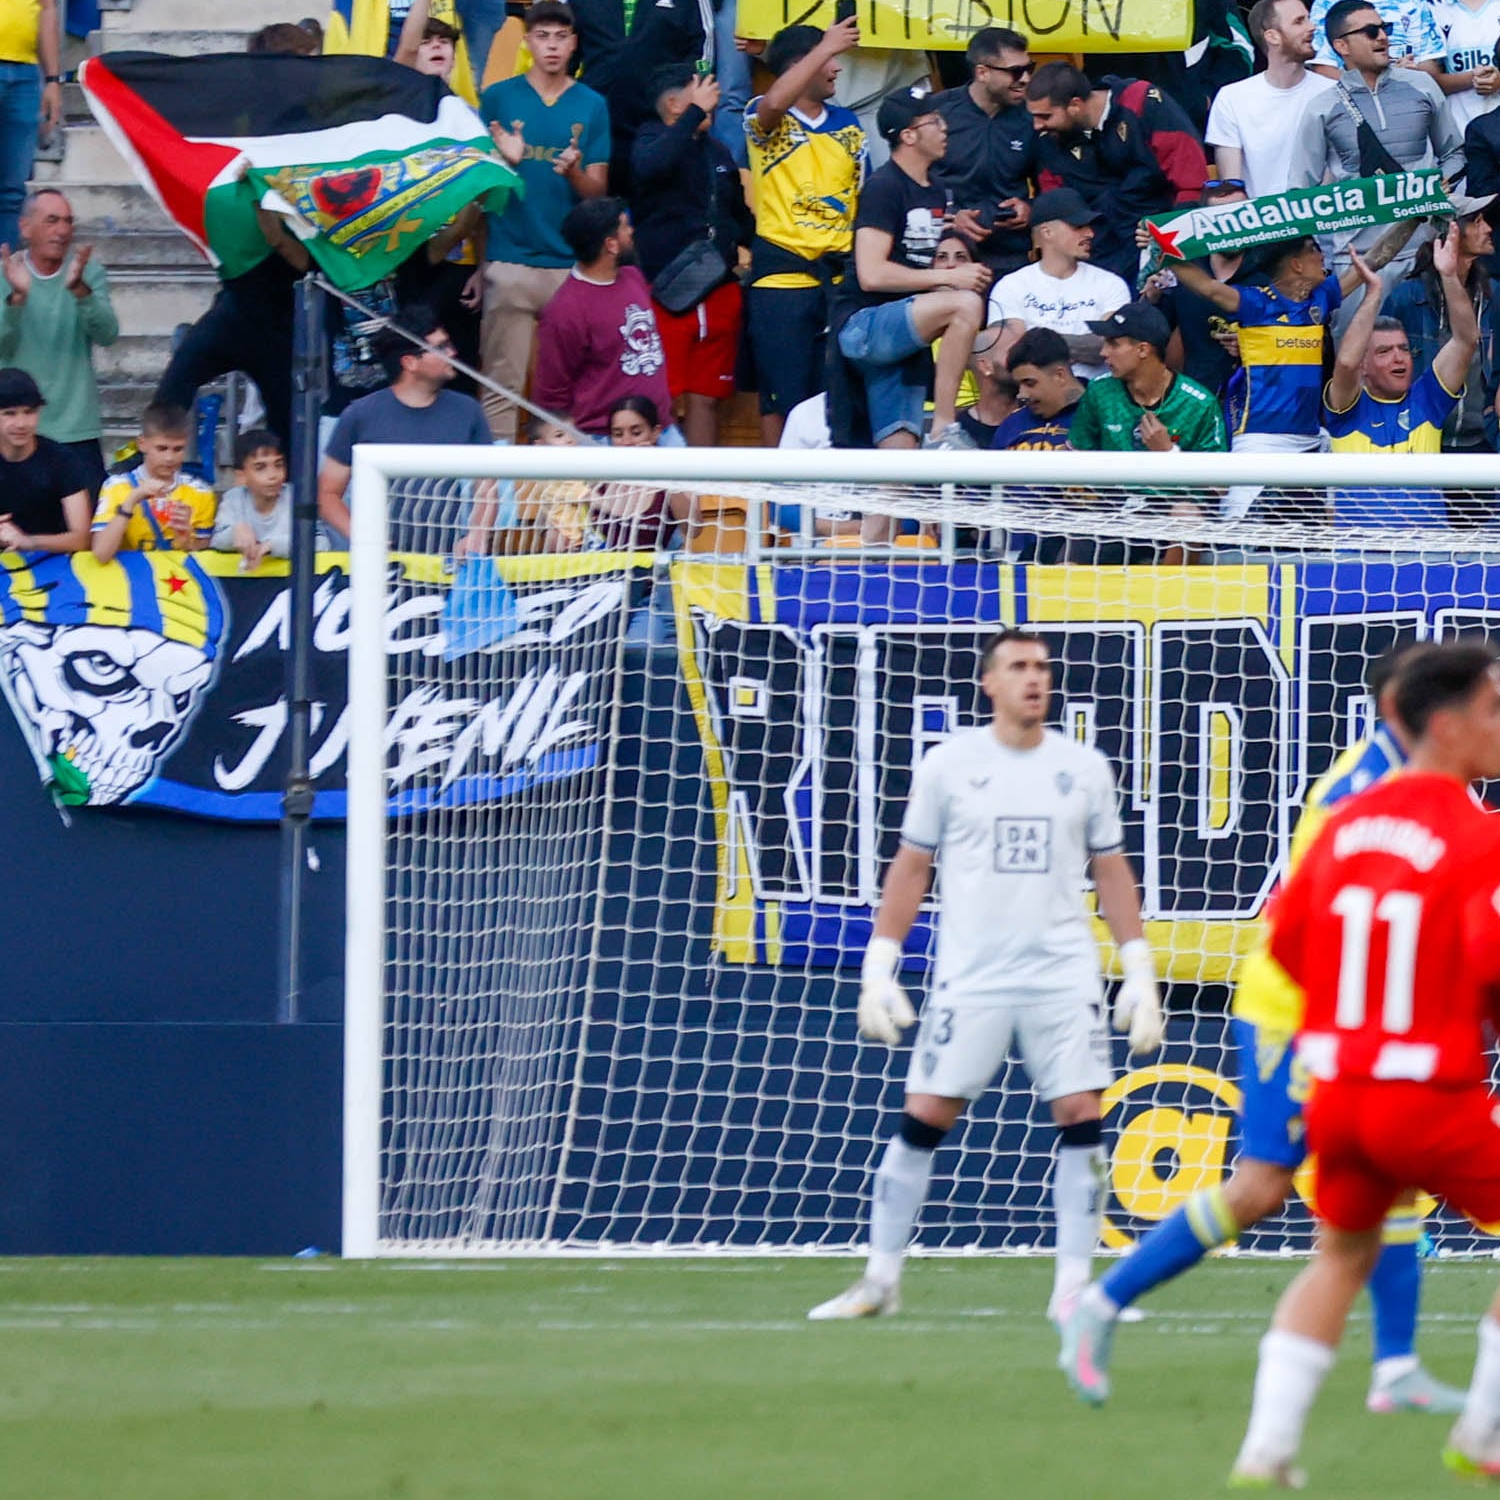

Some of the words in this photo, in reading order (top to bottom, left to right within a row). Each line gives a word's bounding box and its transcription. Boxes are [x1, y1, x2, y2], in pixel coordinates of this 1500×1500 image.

[1452, 49, 1498, 72] Silb
[1195, 184, 1366, 241] Andalucía
[1374, 168, 1442, 206] Libr
[1205, 226, 1300, 253] Independencia
[1315, 212, 1377, 233] República
[1392, 200, 1453, 220] Socialism
[1023, 292, 1058, 312] Pepe
[1058, 297, 1097, 320] Jeans
[1328, 886, 1425, 1037] 11
